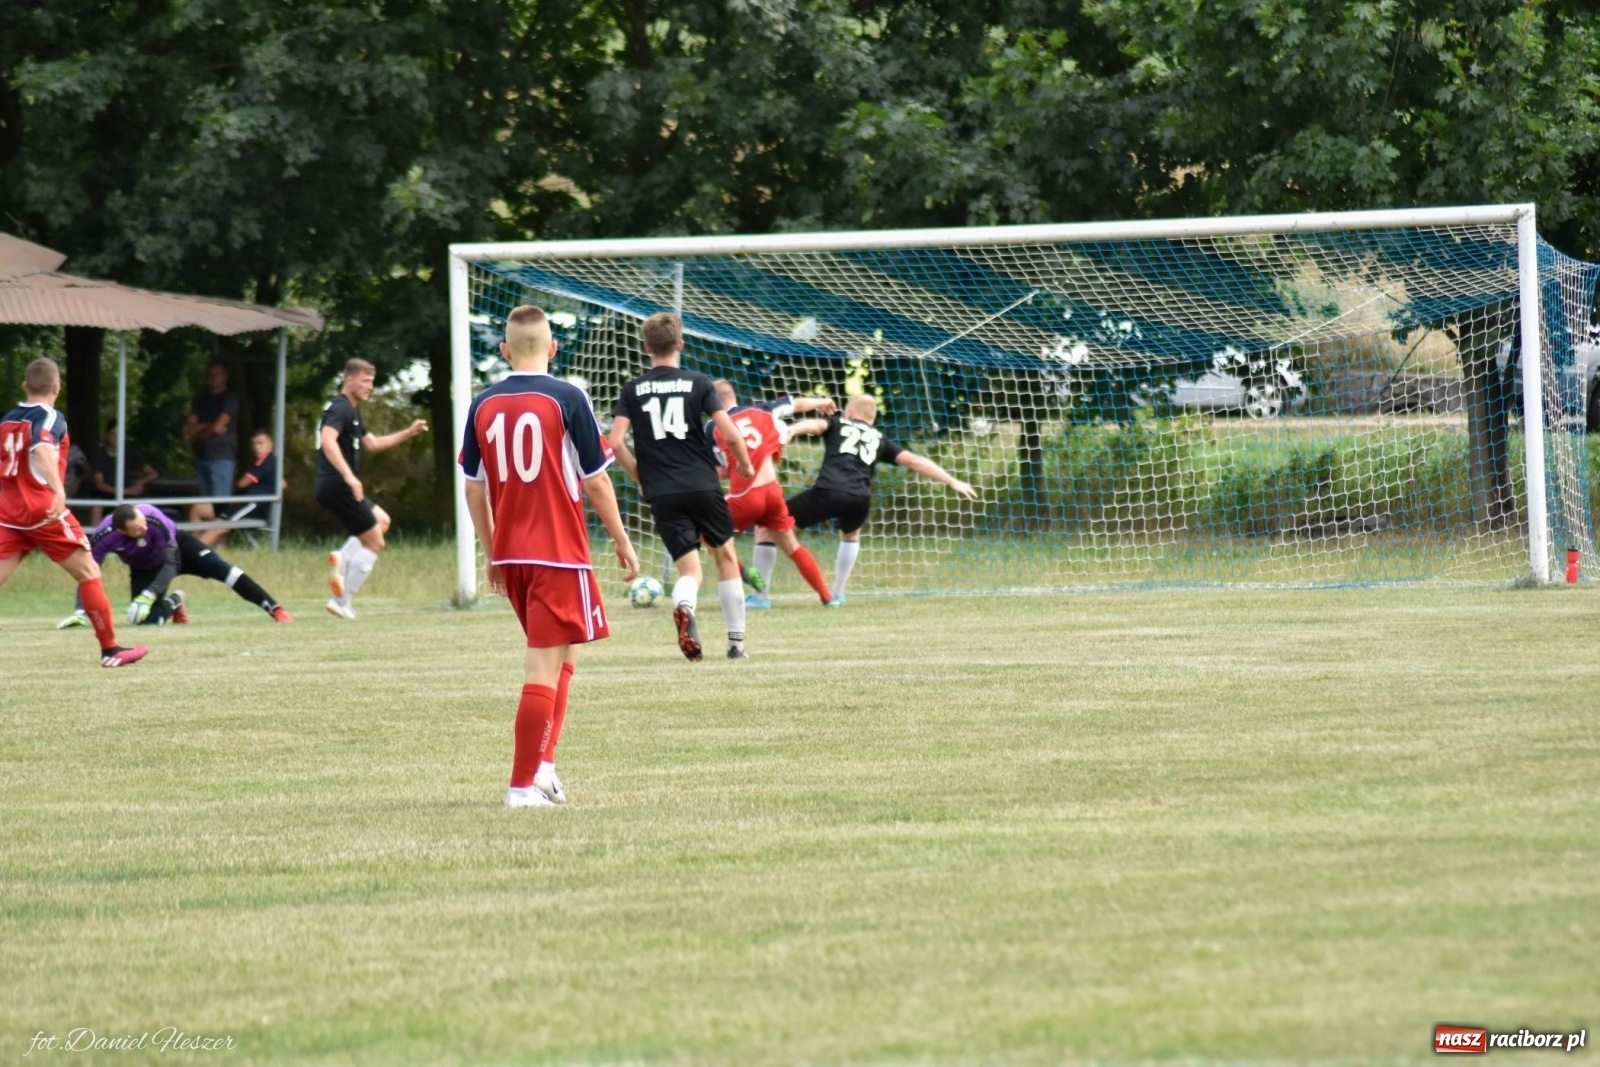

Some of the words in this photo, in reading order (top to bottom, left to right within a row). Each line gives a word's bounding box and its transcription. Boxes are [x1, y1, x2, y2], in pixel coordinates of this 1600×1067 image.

[642, 397, 688, 440] 14
[735, 417, 763, 450] 5
[485, 412, 543, 483] 10
[839, 425, 881, 466] 23
